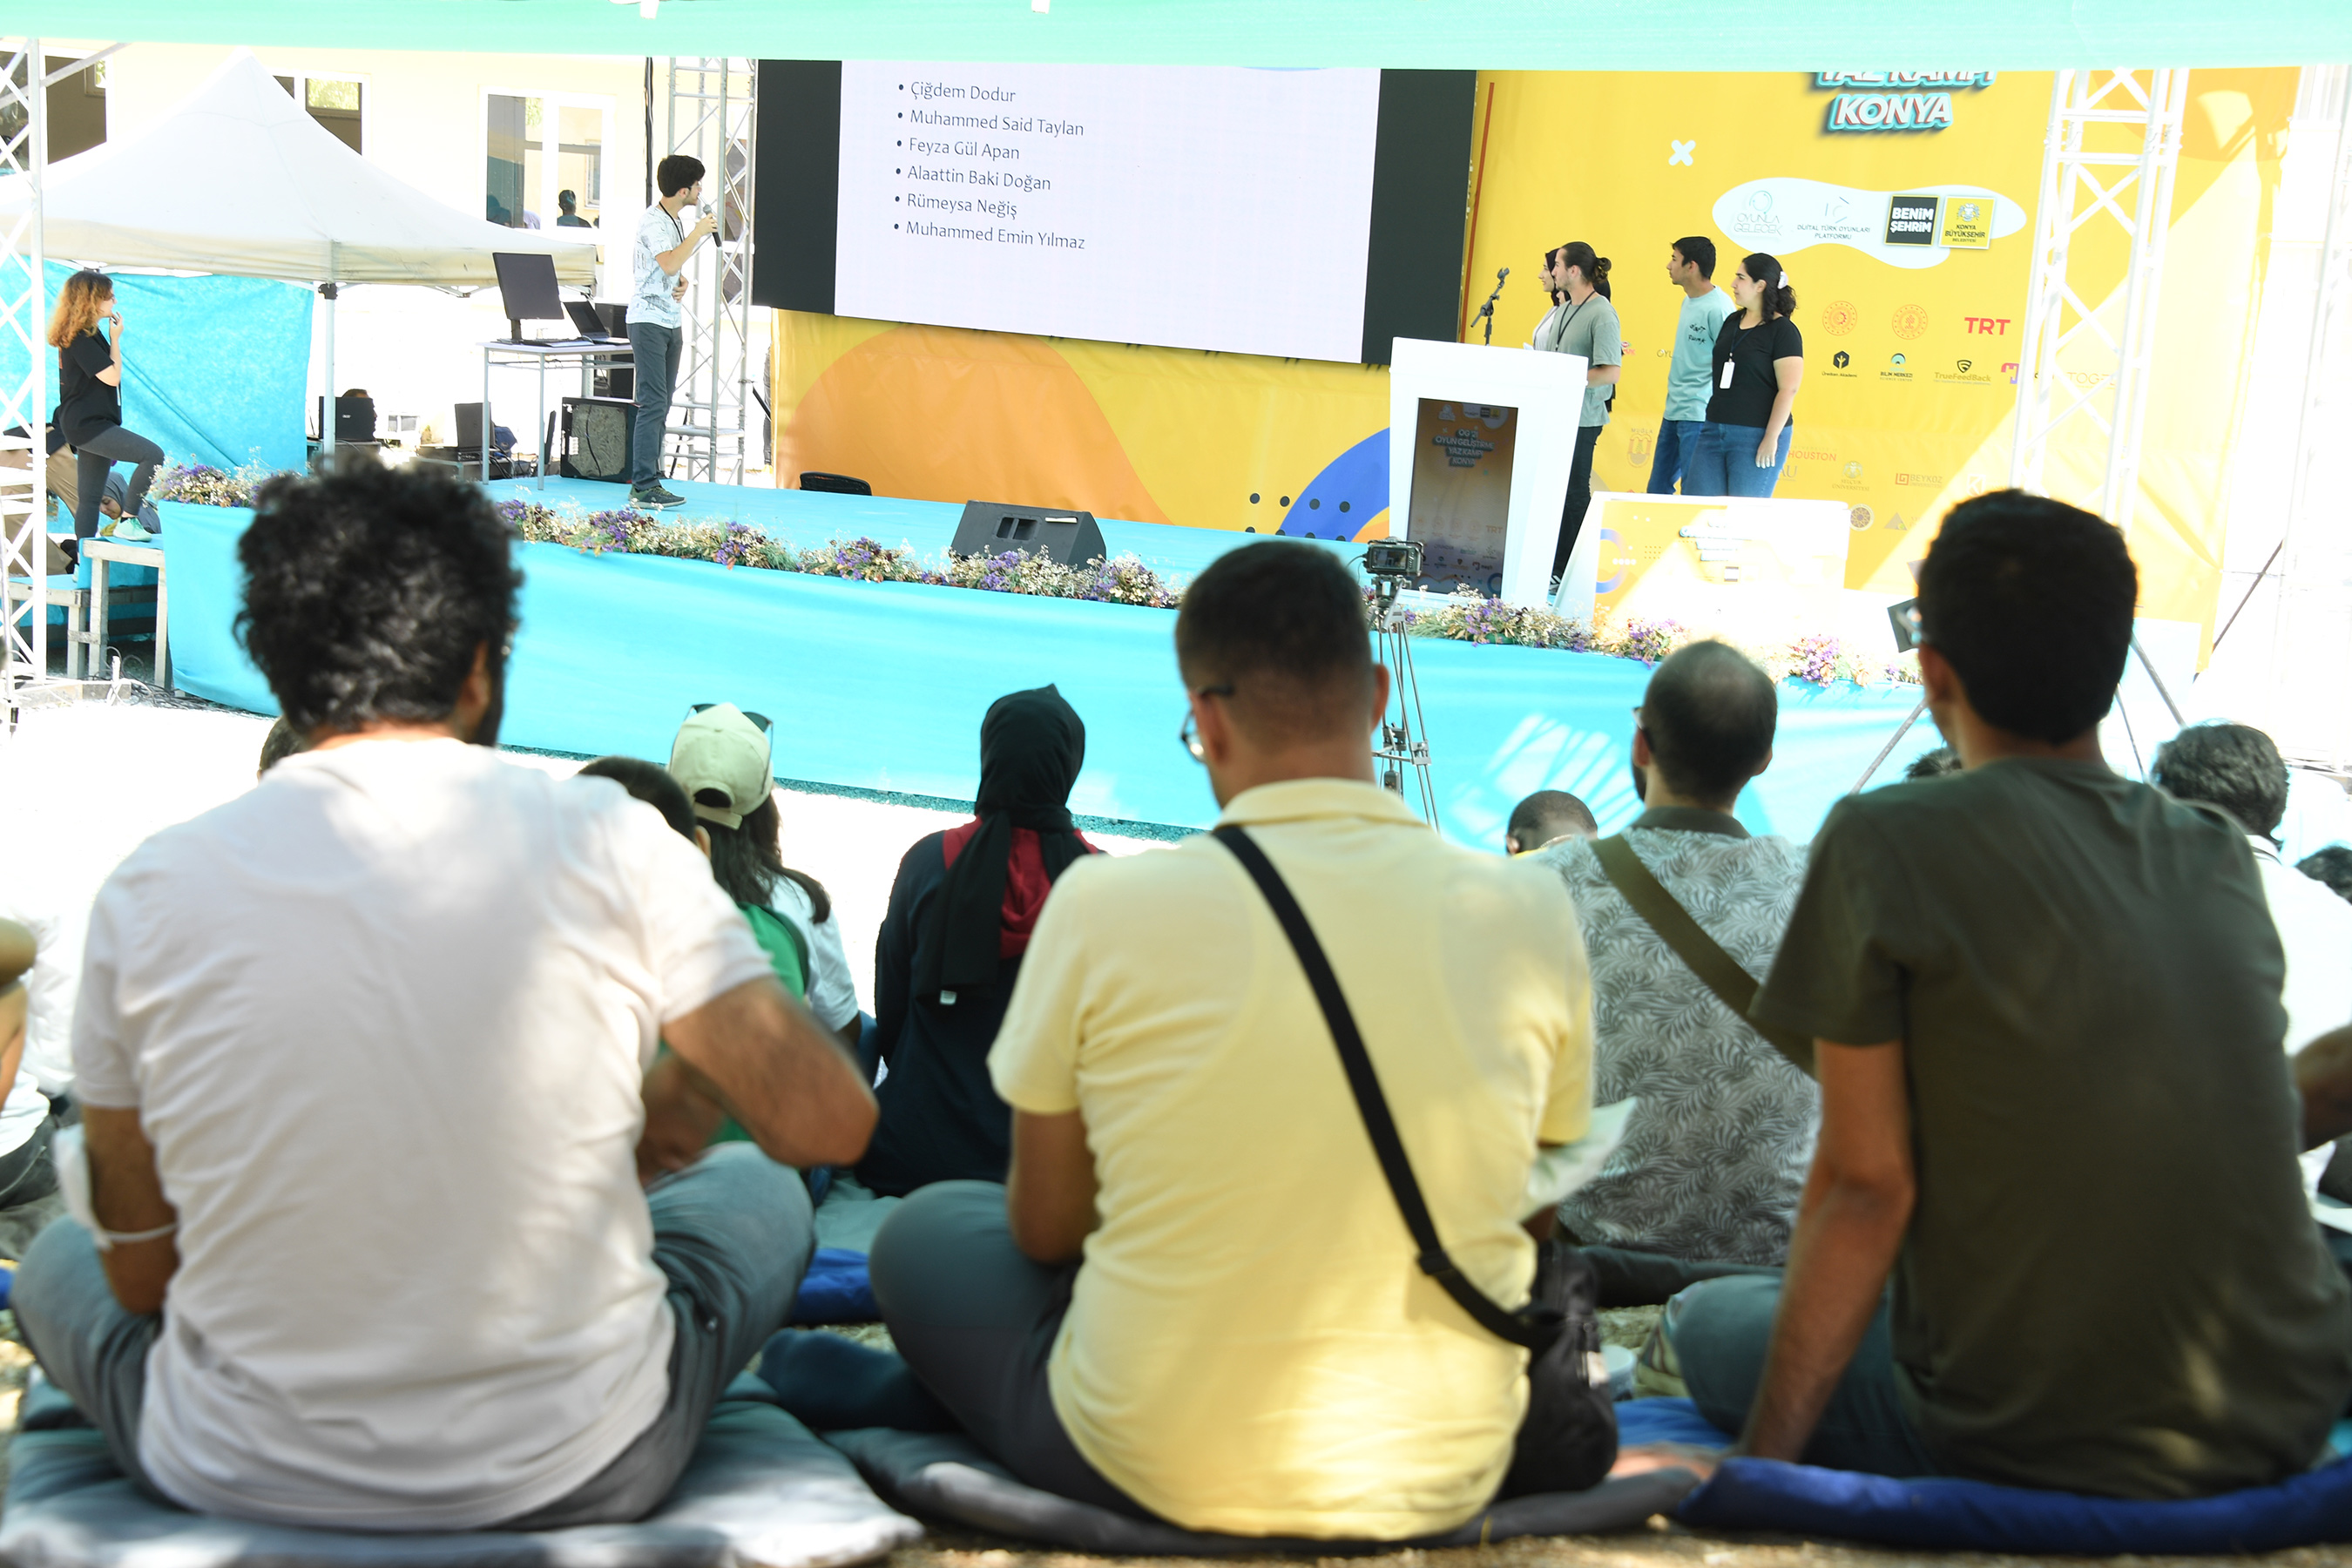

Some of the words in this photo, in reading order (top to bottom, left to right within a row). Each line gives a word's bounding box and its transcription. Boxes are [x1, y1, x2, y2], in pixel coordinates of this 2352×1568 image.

[910, 81, 966, 100] Çiğdem
[970, 85, 1016, 102] Dodur
[1834, 95, 1950, 125] KONYA
[909, 109, 998, 130] Muhammed
[1002, 117, 1032, 132] Said
[1037, 118, 1084, 138] Taylan
[909, 138, 950, 156] Feyza
[954, 140, 977, 157] Gül
[981, 143, 1020, 161] Apan
[907, 166, 964, 184] Alaattin
[969, 170, 999, 186] Baki
[1004, 173, 1051, 193] Doğan
[907, 193, 972, 214] Rümeysa
[977, 199, 1017, 220] Neğiş
[906, 220, 993, 242] Muhammed
[997, 228, 1033, 245] Emin
[1037, 232, 1085, 249] Yılmaz
[1734, 223, 1783, 236] GELECEK
[1963, 316, 2011, 335] TRT
[1935, 372, 1991, 382] TrueFeedBack
[1435, 436, 1457, 444] OYUN
[1788, 450, 1837, 462] HOUSTON
[1910, 474, 1943, 483] BEYKOZ
